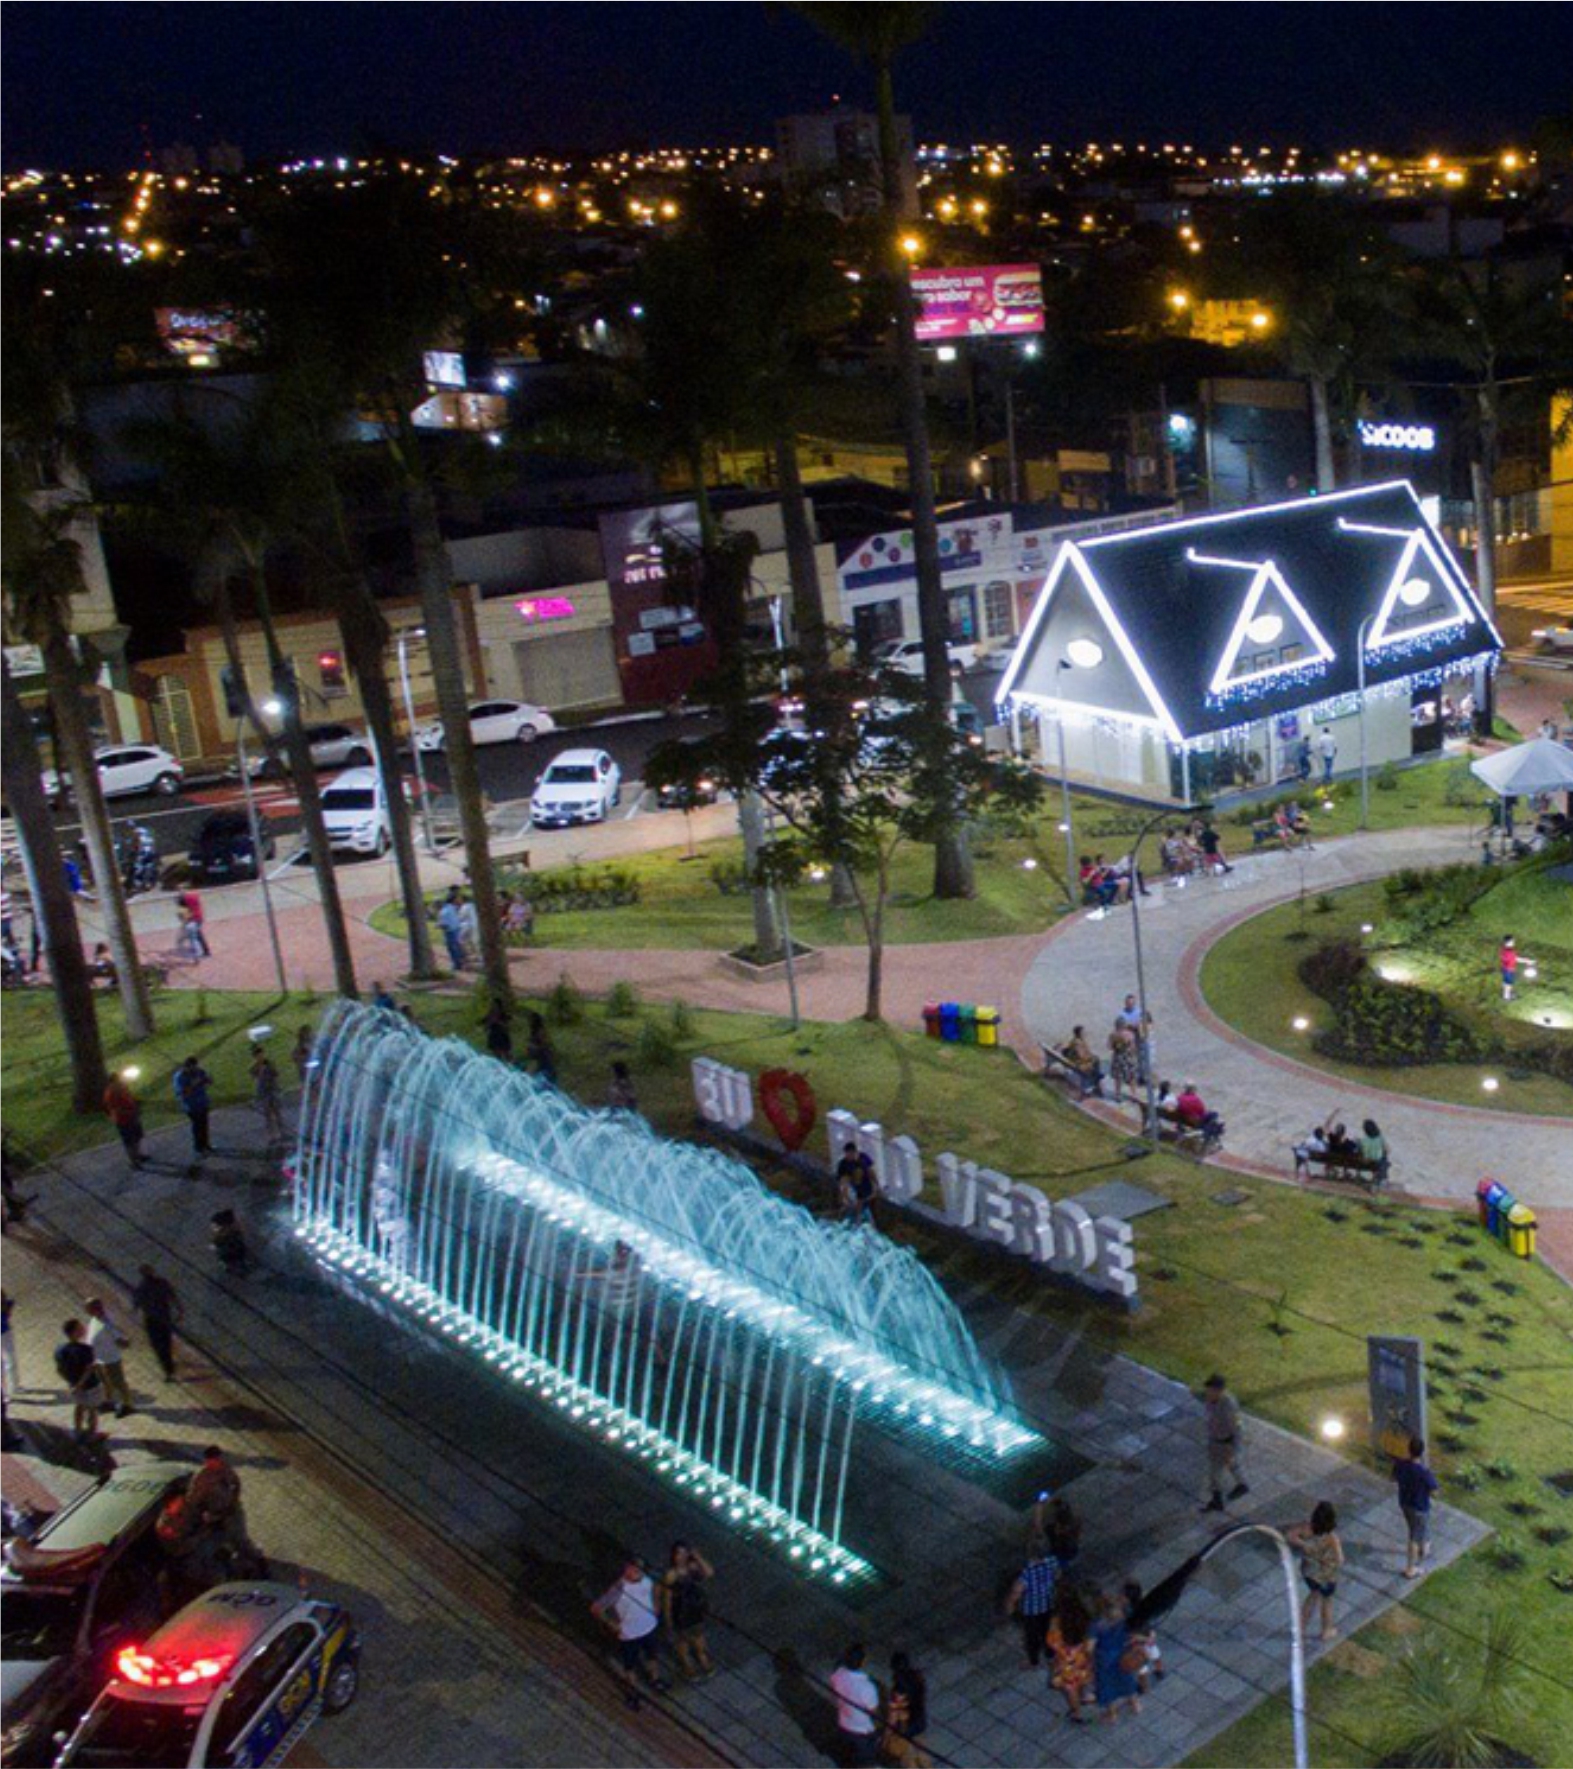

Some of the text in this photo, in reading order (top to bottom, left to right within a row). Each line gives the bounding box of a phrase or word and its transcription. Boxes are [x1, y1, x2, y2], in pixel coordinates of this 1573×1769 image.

[910, 275, 962, 290] escubra
[691, 1056, 754, 1131] EU
[936, 1151, 1138, 1297] VERDE
